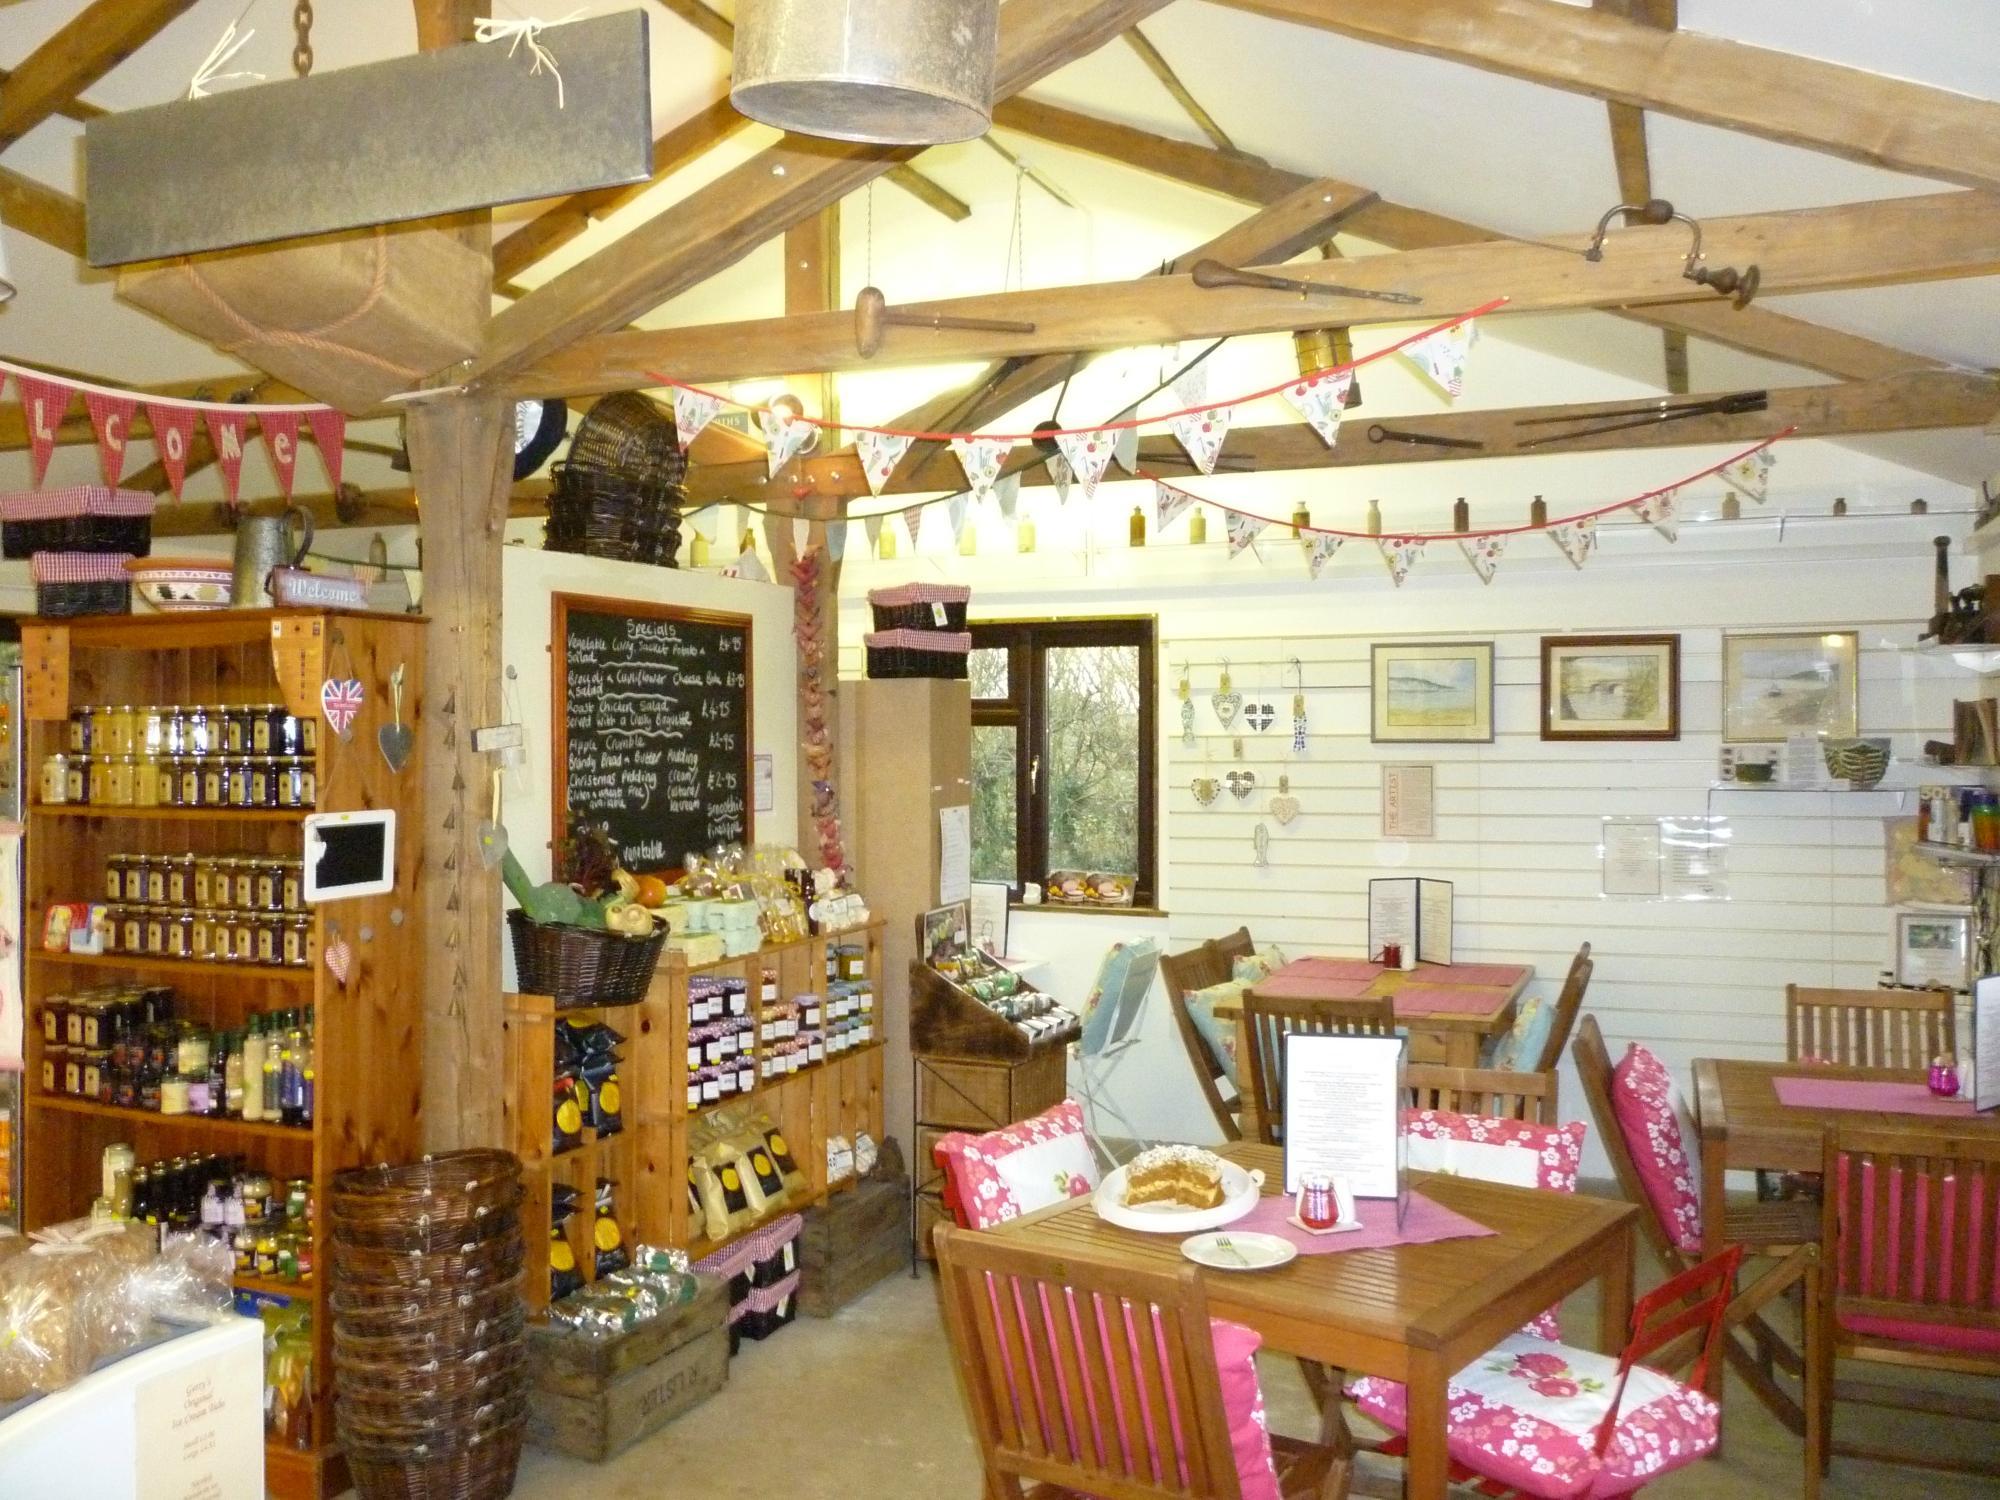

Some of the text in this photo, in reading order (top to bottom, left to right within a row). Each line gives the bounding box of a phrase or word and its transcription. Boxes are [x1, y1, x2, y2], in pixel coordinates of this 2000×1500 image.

[288, 579, 359, 602] Welcome
[626, 619, 677, 637] Specials
[640, 699, 669, 712] Salad
[569, 738, 598, 755] Apple
[605, 735, 646, 751] Crumble
[568, 752, 597, 773] Brandy
[569, 773, 617, 787] Christmas
[621, 769, 657, 790] Pudding
[1388, 772, 1400, 830] THE ARTIST
